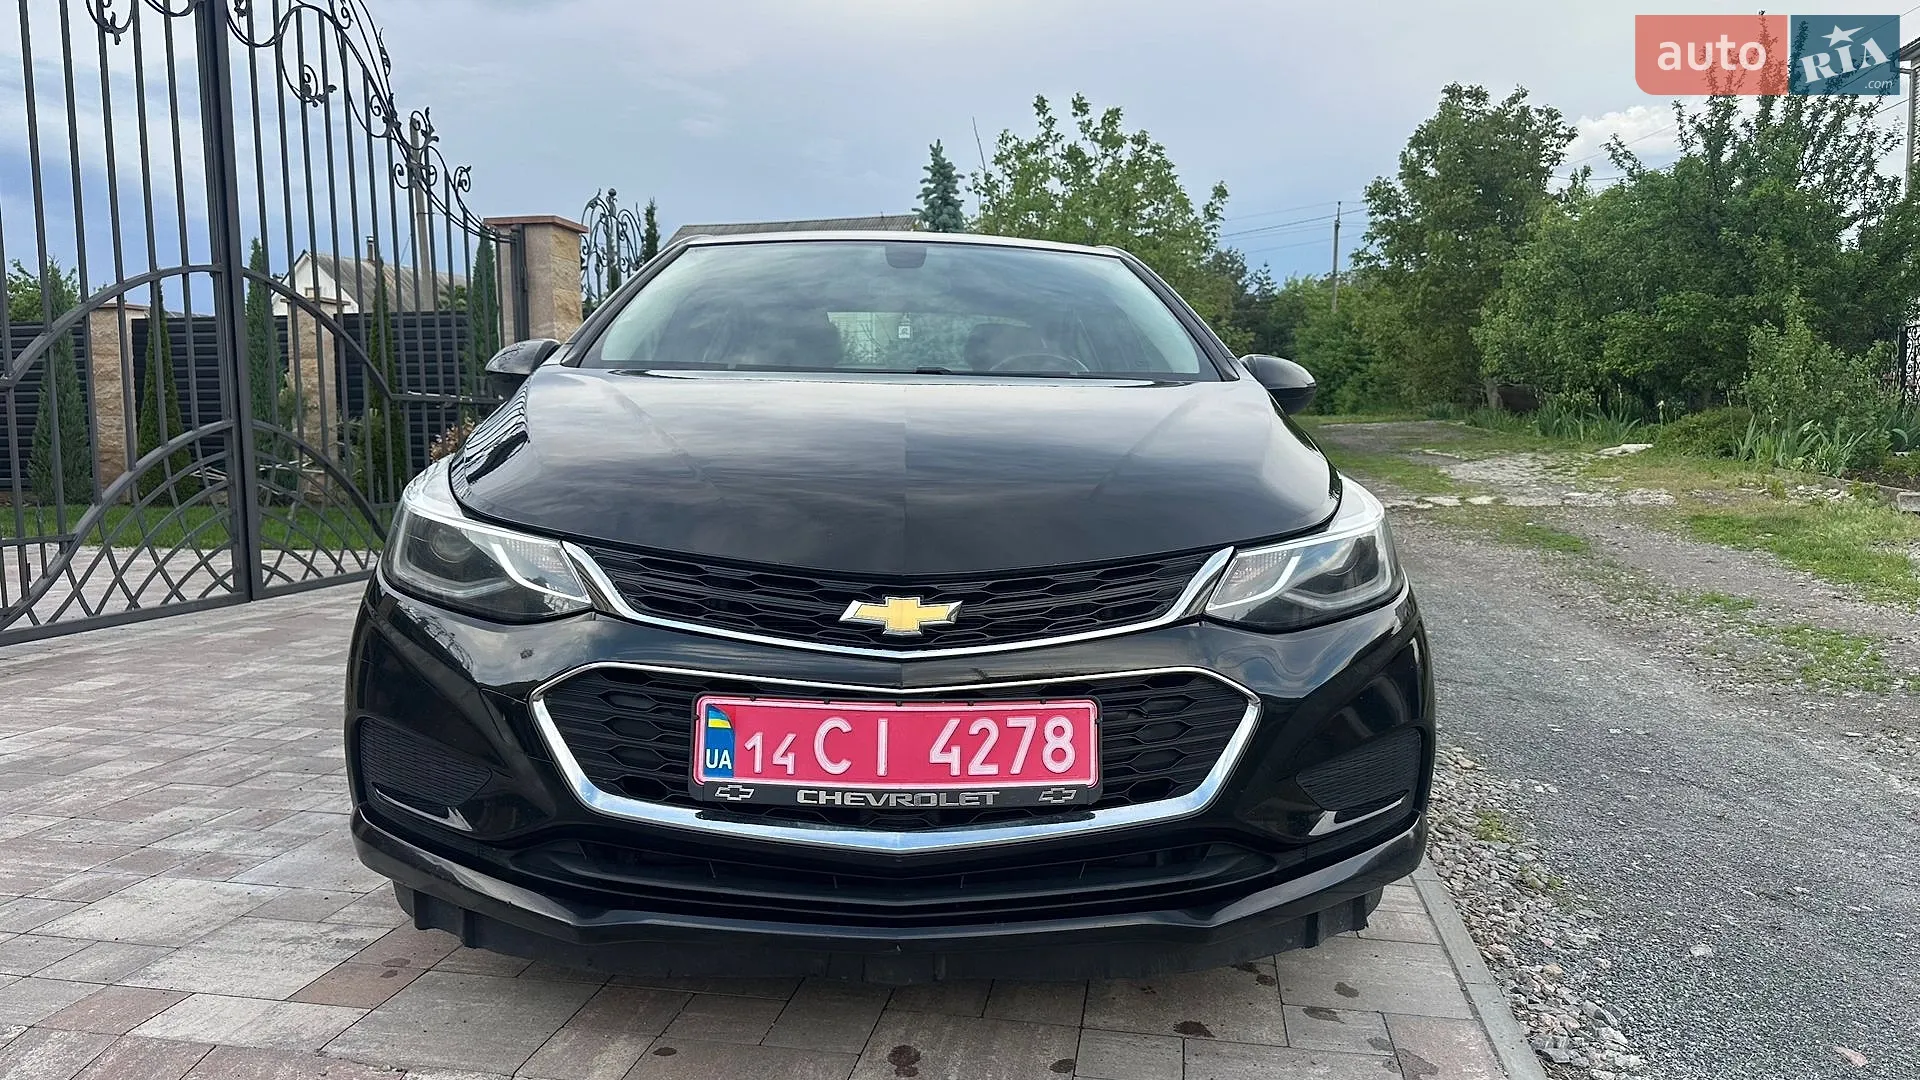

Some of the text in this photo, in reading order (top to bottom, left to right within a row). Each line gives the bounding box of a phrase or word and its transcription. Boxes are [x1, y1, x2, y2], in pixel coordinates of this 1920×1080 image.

[744, 716, 1076, 776] 14 CI 4278
[706, 748, 732, 769] UA
[796, 790, 1000, 807] CHEVROLET
